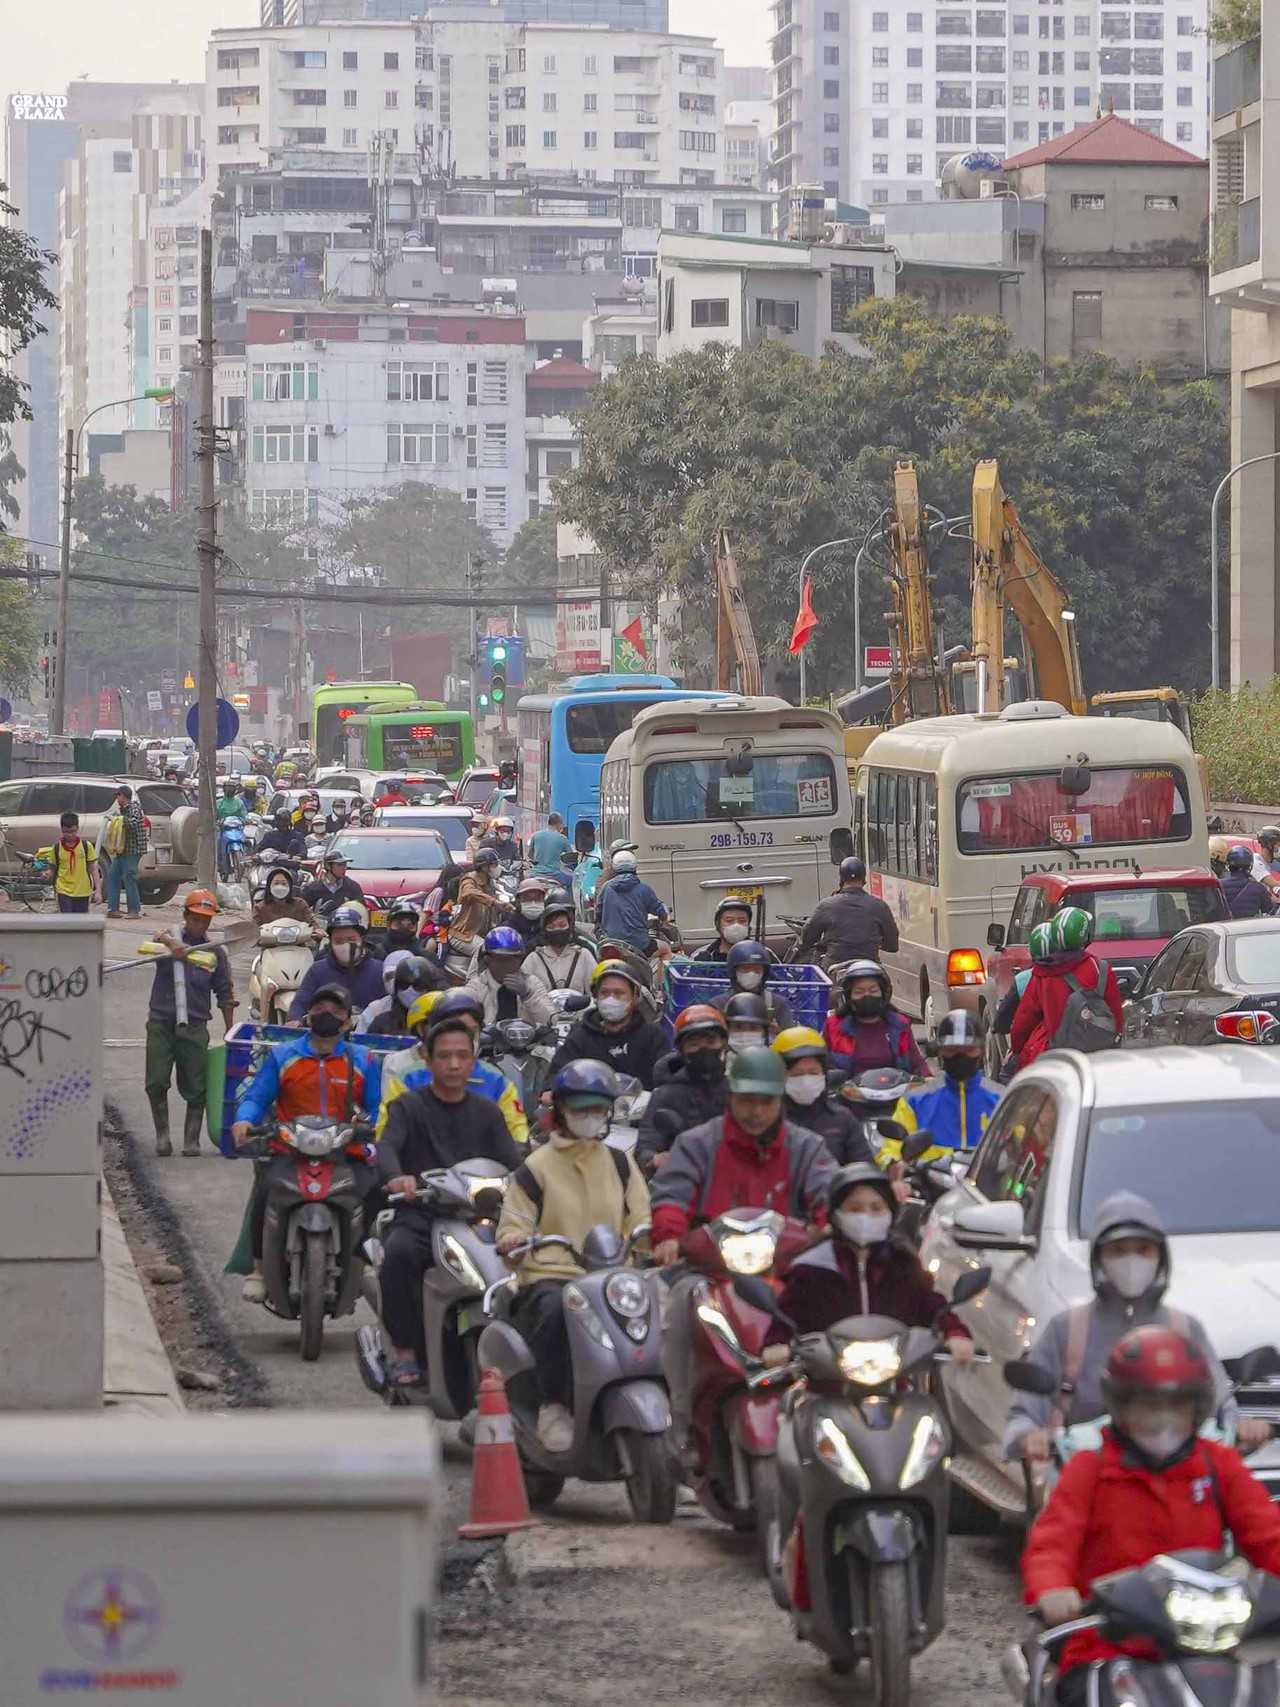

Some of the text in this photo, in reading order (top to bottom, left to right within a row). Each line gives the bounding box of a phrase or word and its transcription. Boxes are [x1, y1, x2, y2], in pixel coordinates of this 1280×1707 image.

[11, 95, 68, 108] GRAND
[13, 107, 65, 120] PLAZA
[710, 832, 774, 848] 29B-159.73
[1054, 829, 1073, 842] 39
